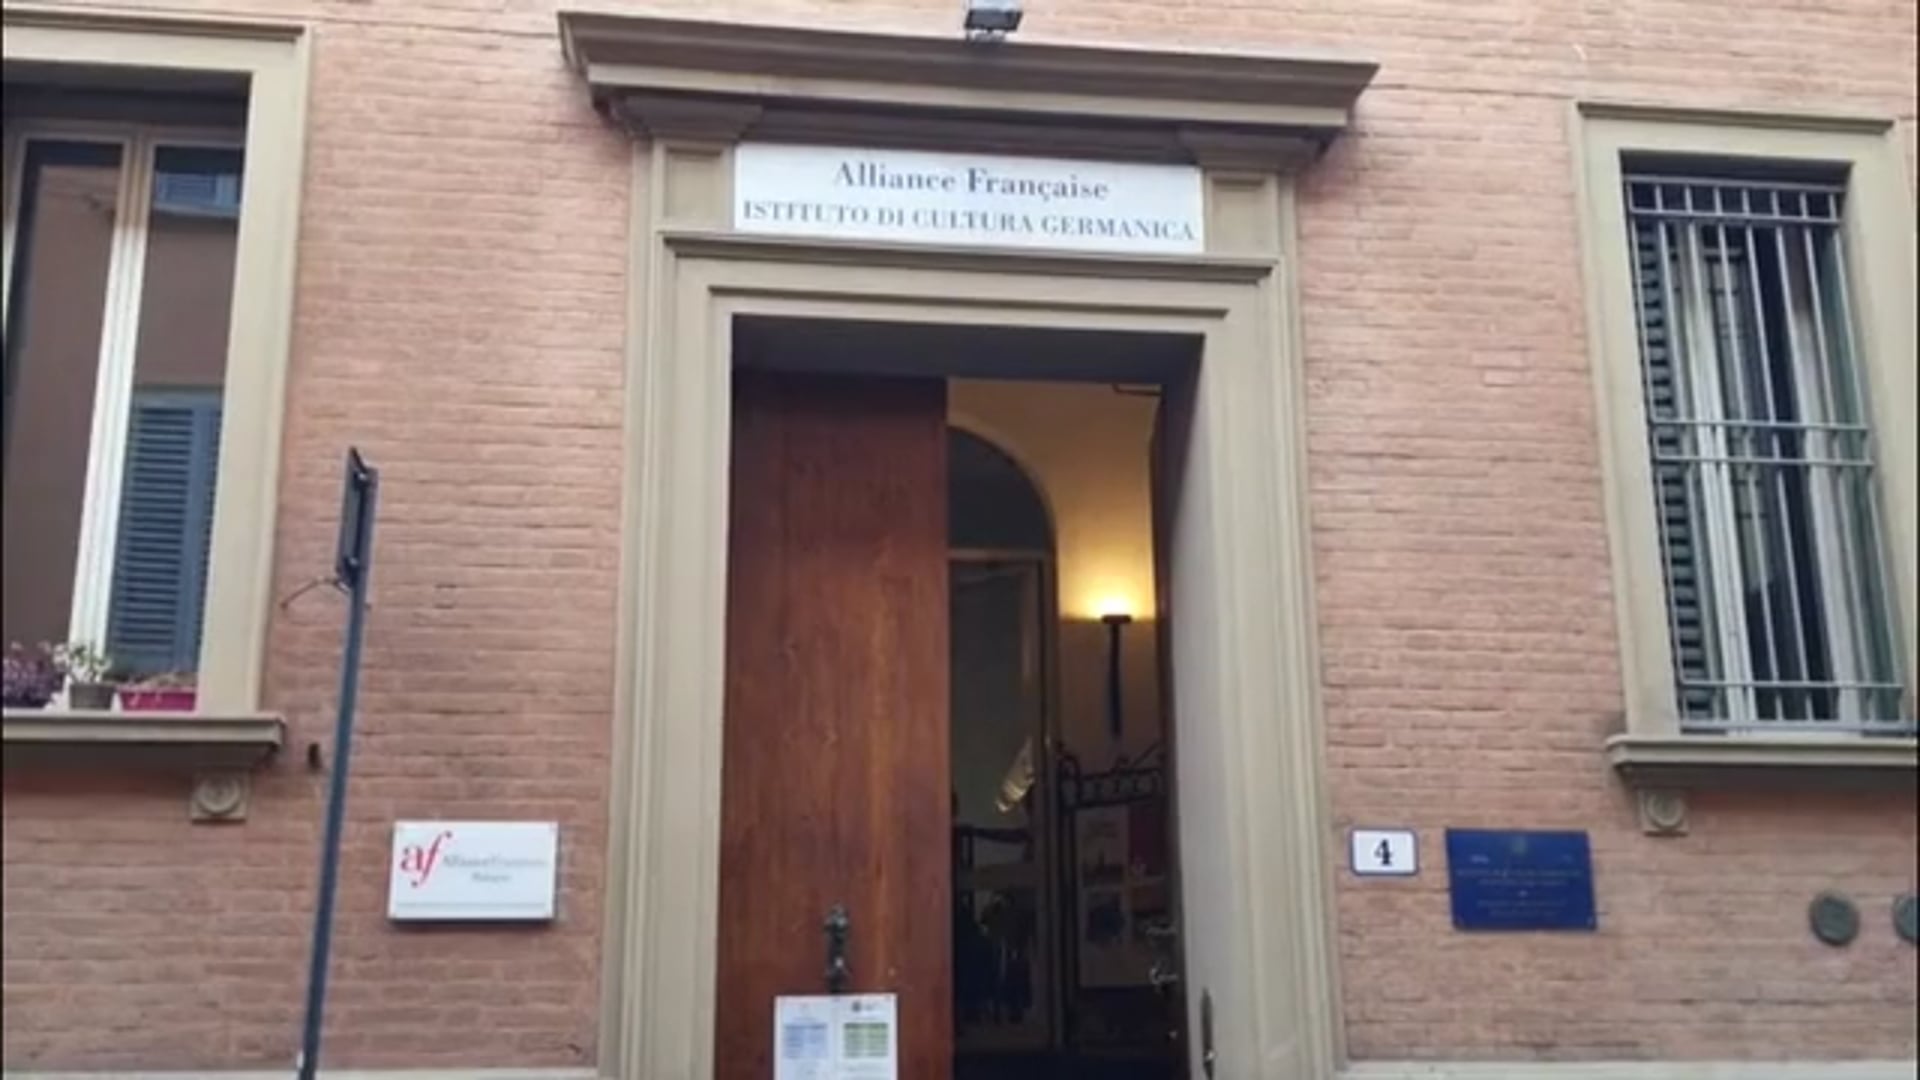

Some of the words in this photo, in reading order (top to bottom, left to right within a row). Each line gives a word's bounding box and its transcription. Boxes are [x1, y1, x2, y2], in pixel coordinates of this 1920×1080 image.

[834, 160, 956, 190] Alliance
[968, 167, 1109, 201] Française
[743, 200, 869, 224] ISTITUTO
[878, 206, 904, 227] DI
[911, 208, 1032, 233] CULTURA
[1041, 213, 1195, 241] GERMANICA
[400, 830, 453, 888] af
[1374, 839, 1393, 866] 4
